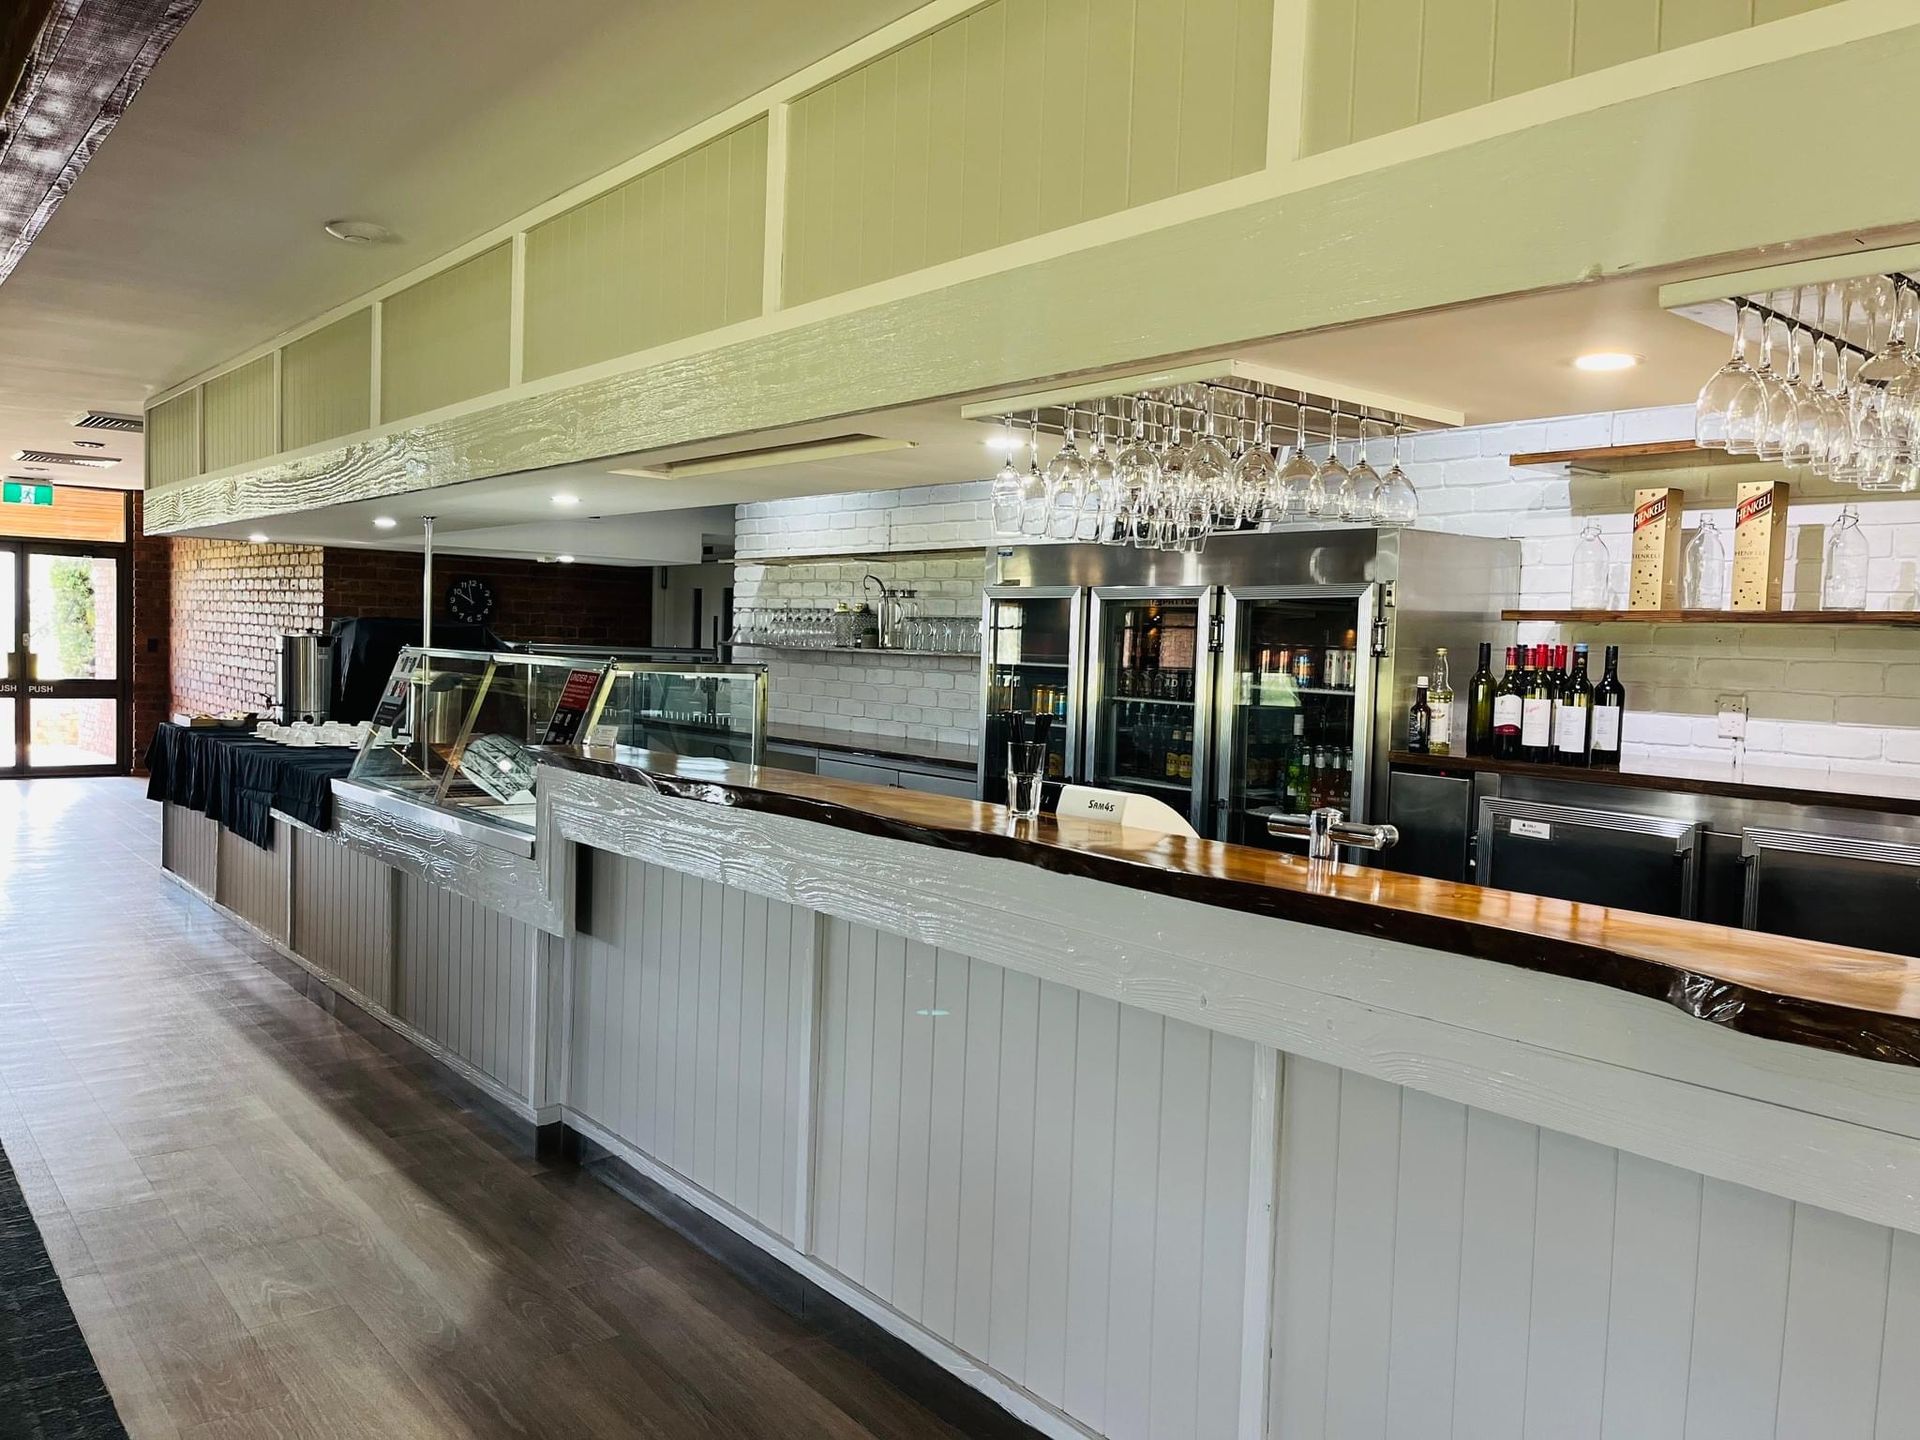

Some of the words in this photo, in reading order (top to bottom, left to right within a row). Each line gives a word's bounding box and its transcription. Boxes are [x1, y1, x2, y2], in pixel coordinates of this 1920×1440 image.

[1634, 499, 1666, 529] HENKELL
[1736, 492, 1773, 524] HENKELL
[467, 615, 473, 623] 6
[28, 685, 53, 693] PUSH
